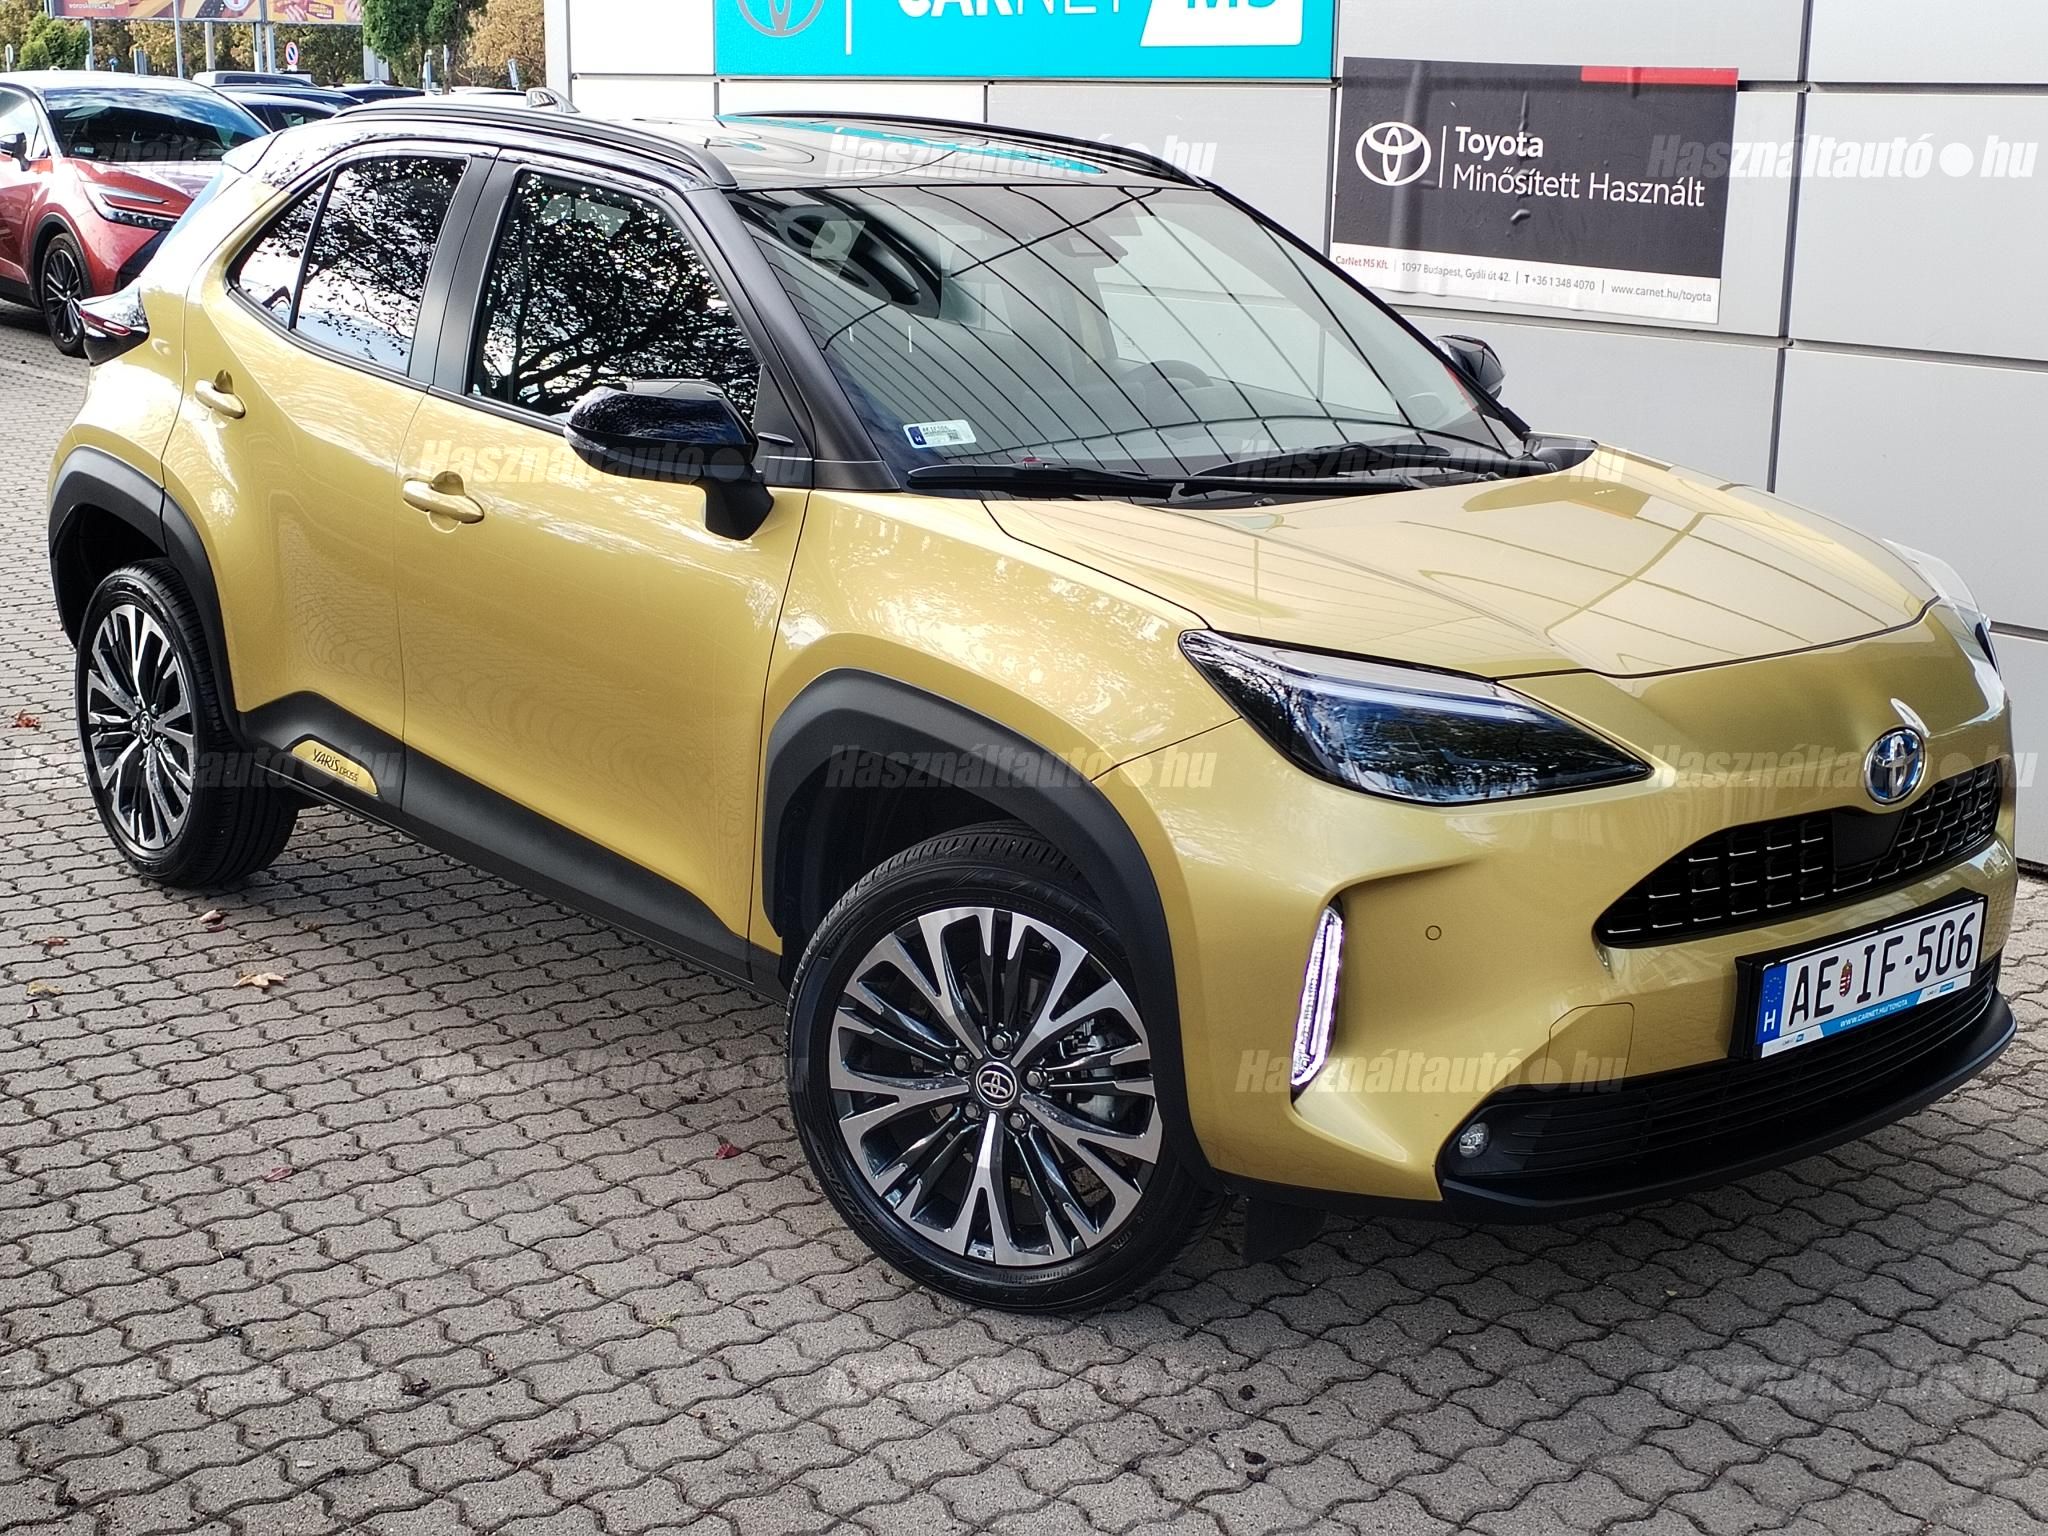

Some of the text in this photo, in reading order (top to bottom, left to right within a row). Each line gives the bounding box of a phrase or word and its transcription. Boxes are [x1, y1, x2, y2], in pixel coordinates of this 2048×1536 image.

[1454, 126, 1544, 161] Toyota
[1452, 163, 1706, 207] Minősített Használt
[1401, 262, 1421, 273] 1097
[1423, 264, 1463, 278] Budapest,
[1532, 275, 1548, 286] +36
[1555, 277, 1572, 288] 348
[1573, 279, 1596, 291] 4070
[1611, 283, 1712, 303] www.carnet.hu/toyota
[1788, 912, 1976, 1026] AE IF-506
[1763, 1009, 1776, 1033] H
